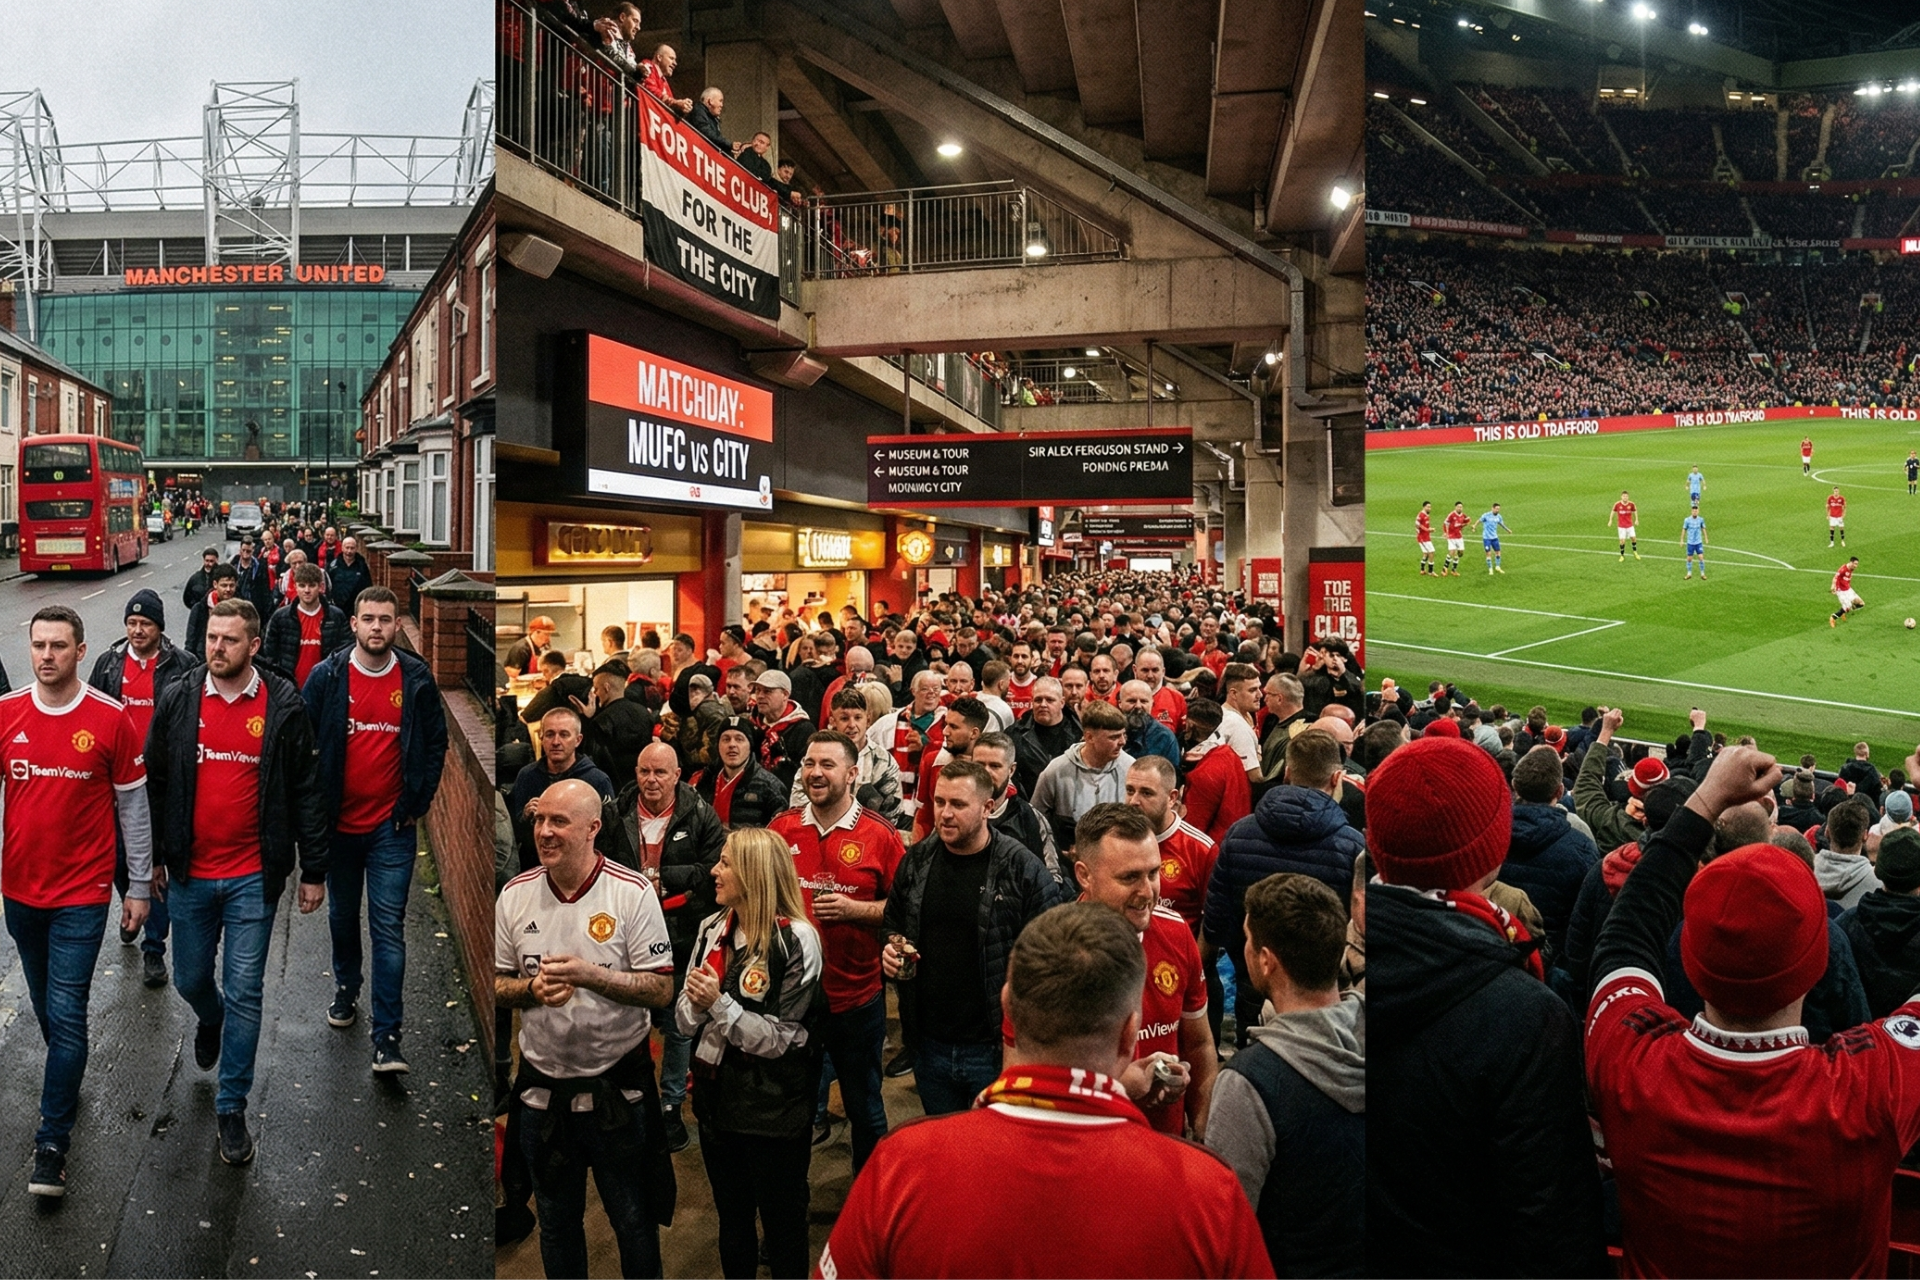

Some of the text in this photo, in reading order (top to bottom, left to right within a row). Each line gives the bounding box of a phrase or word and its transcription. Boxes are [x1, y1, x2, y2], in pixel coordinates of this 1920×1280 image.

[649, 108, 772, 225] FOR THE CLUB,
[682, 188, 752, 255] FOR THE
[125, 264, 384, 285] MANCHESTER UNITED
[677, 237, 757, 301] THE CITY
[638, 360, 744, 428] MATCHDAY:
[1705, 411, 1723, 425] OLD
[1840, 407, 1918, 421] THIS IS OLD
[1473, 420, 1599, 442] THIS IS OLD TRAFFORD
[628, 418, 686, 471] MUFC
[713, 437, 750, 480] CITY
[888, 448, 969, 460] MUSEUM & TOUR
[1028, 443, 1169, 457] SIR ALEX FERGUSON STAND
[888, 464, 969, 476] MUSEUM & TOUR
[940, 482, 962, 492] CITY
